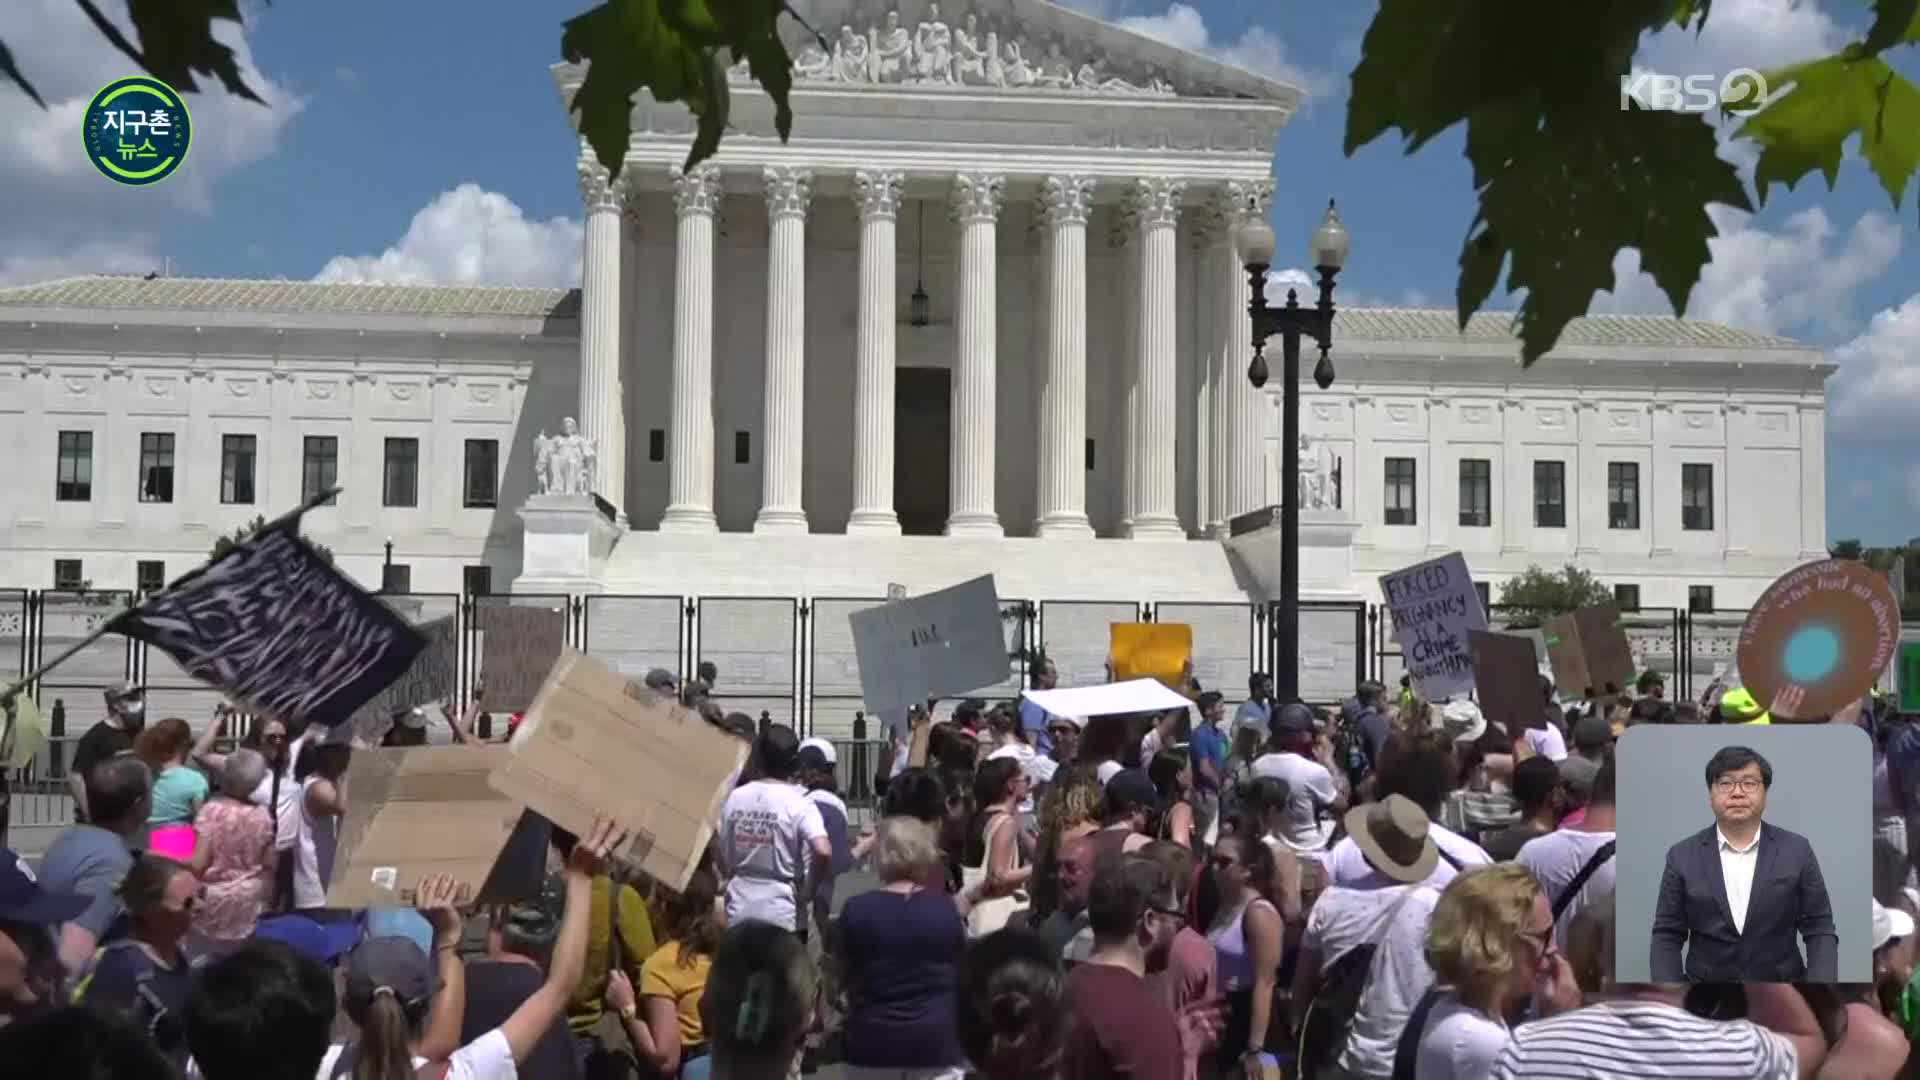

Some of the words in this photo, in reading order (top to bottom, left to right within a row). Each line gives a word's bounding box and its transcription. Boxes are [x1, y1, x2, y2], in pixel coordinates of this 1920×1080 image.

[1386, 564, 1449, 606] FORCED
[1817, 575, 1850, 592] had
[1412, 634, 1461, 662] CRIME
